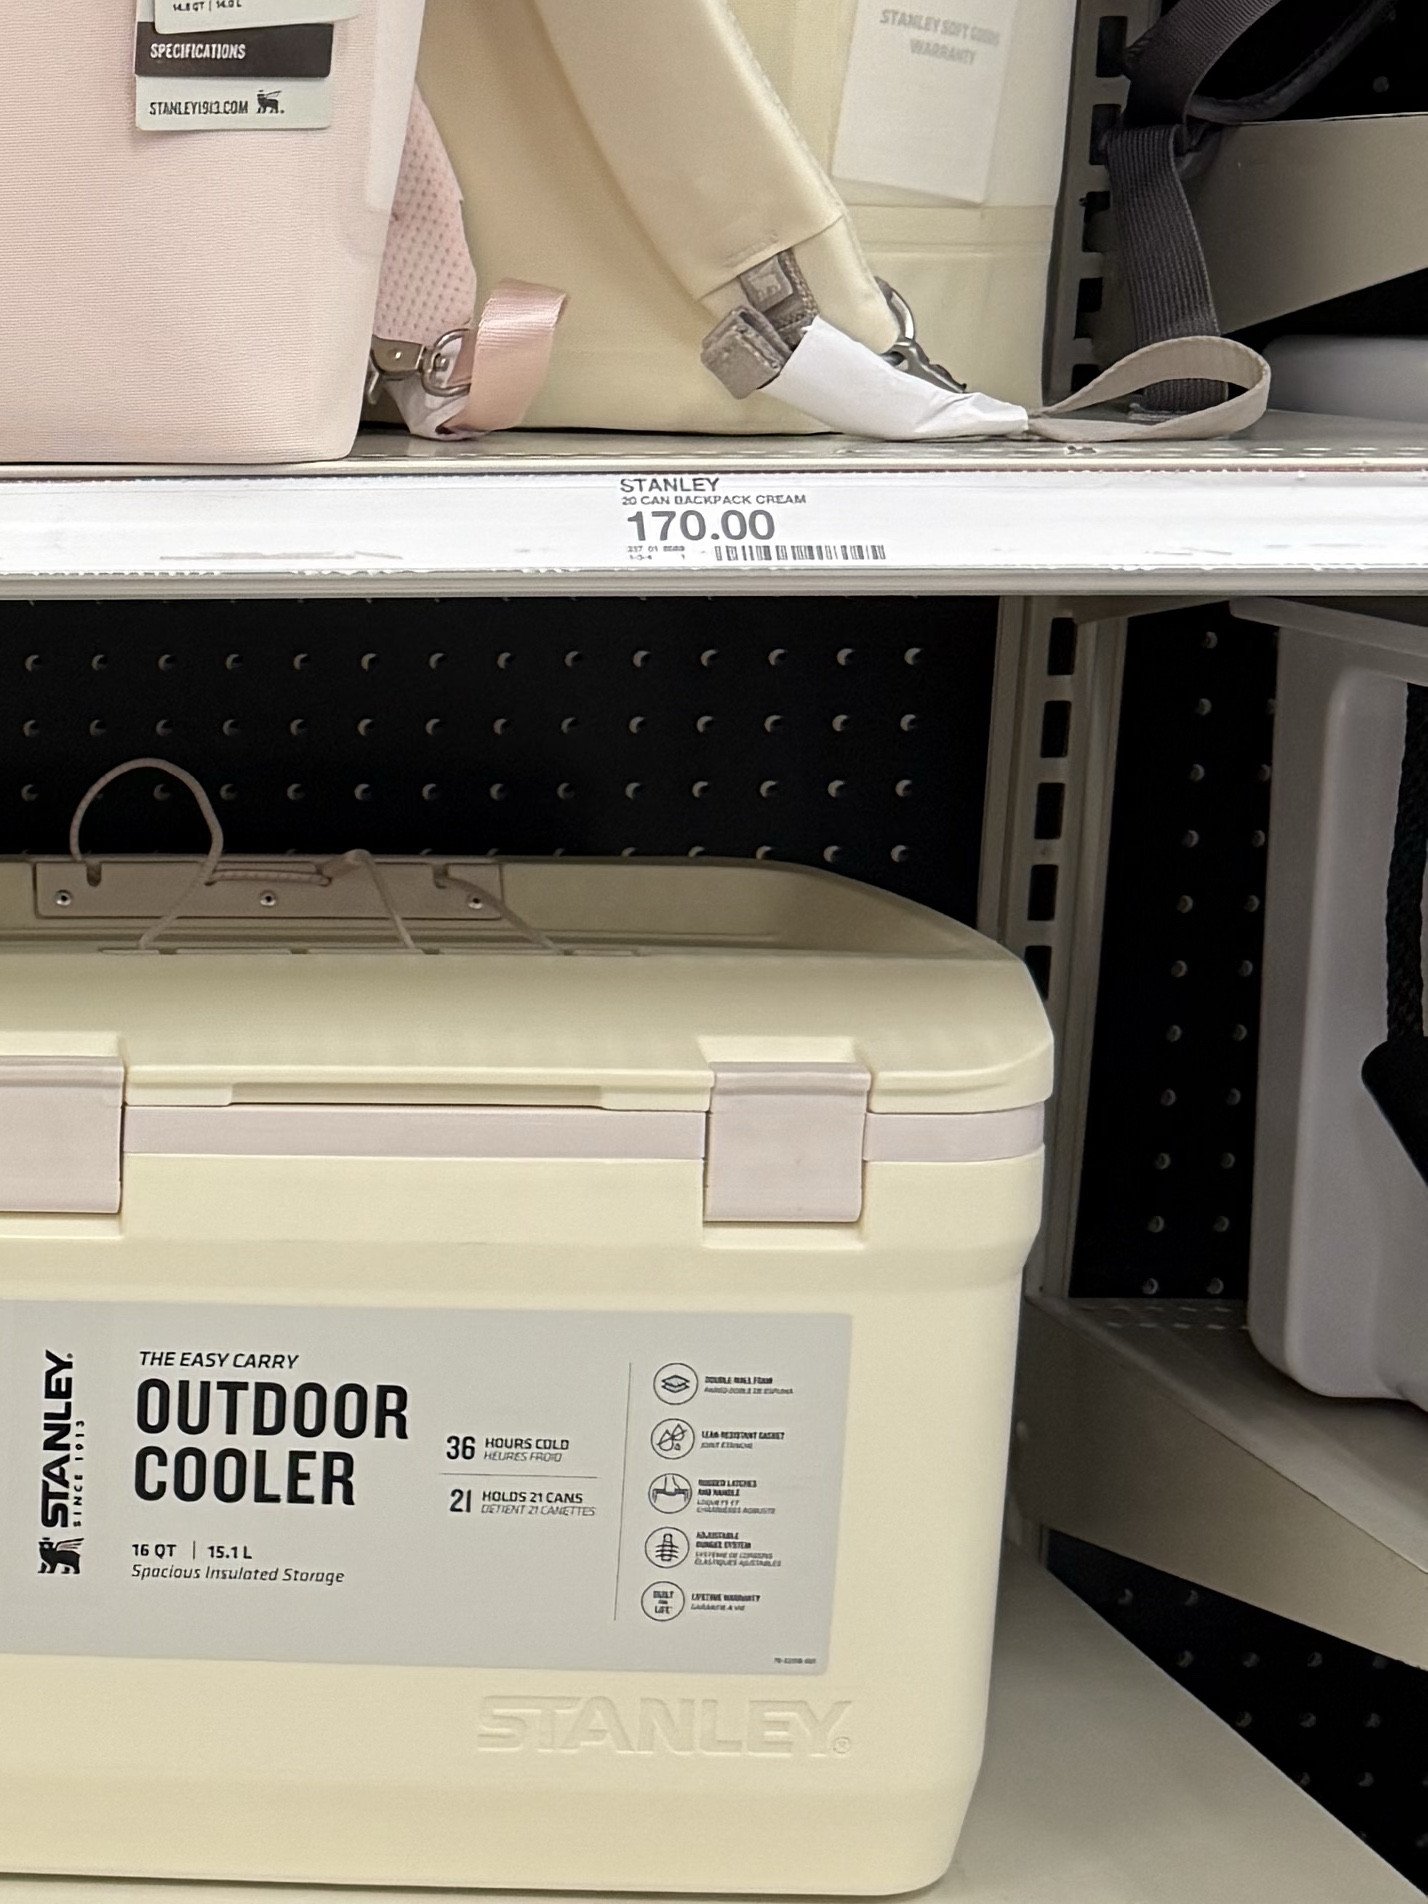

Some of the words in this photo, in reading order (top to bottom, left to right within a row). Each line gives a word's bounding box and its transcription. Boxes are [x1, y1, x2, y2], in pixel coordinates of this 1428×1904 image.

[150, 42, 247, 61] SPECIFICATIONS
[620, 478, 720, 493] STANLEY
[622, 496, 637, 505] 20
[641, 496, 670, 505] CAN
[674, 495, 752, 505] BACKPACK
[755, 494, 807, 504] CREAM
[627, 509, 776, 541] 170.00
[139, 1350, 175, 1367] THE
[180, 1351, 229, 1368] EASY
[233, 1352, 299, 1370] CARRY
[136, 1378, 409, 1440] OUTDOOR
[40, 1349, 75, 1528] STANLEY
[446, 1435, 475, 1460] 36
[485, 1437, 532, 1450] HOURS
[535, 1438, 569, 1450] COLD
[134, 1445, 356, 1506] COOLER
[449, 1488, 472, 1513] 21
[482, 1490, 527, 1502] HOLDS
[530, 1491, 543, 1503] 21
[546, 1492, 583, 1504] CANS
[132, 1543, 150, 1557] 16
[153, 1543, 177, 1559] QT
[207, 1544, 239, 1559] 15.1
[242, 1545, 253, 1559] L
[131, 1563, 201, 1581] Spacious
[205, 1564, 278, 1581] Insulated
[282, 1566, 345, 1586] Storage
[477, 1695, 852, 1757] STANLEY
